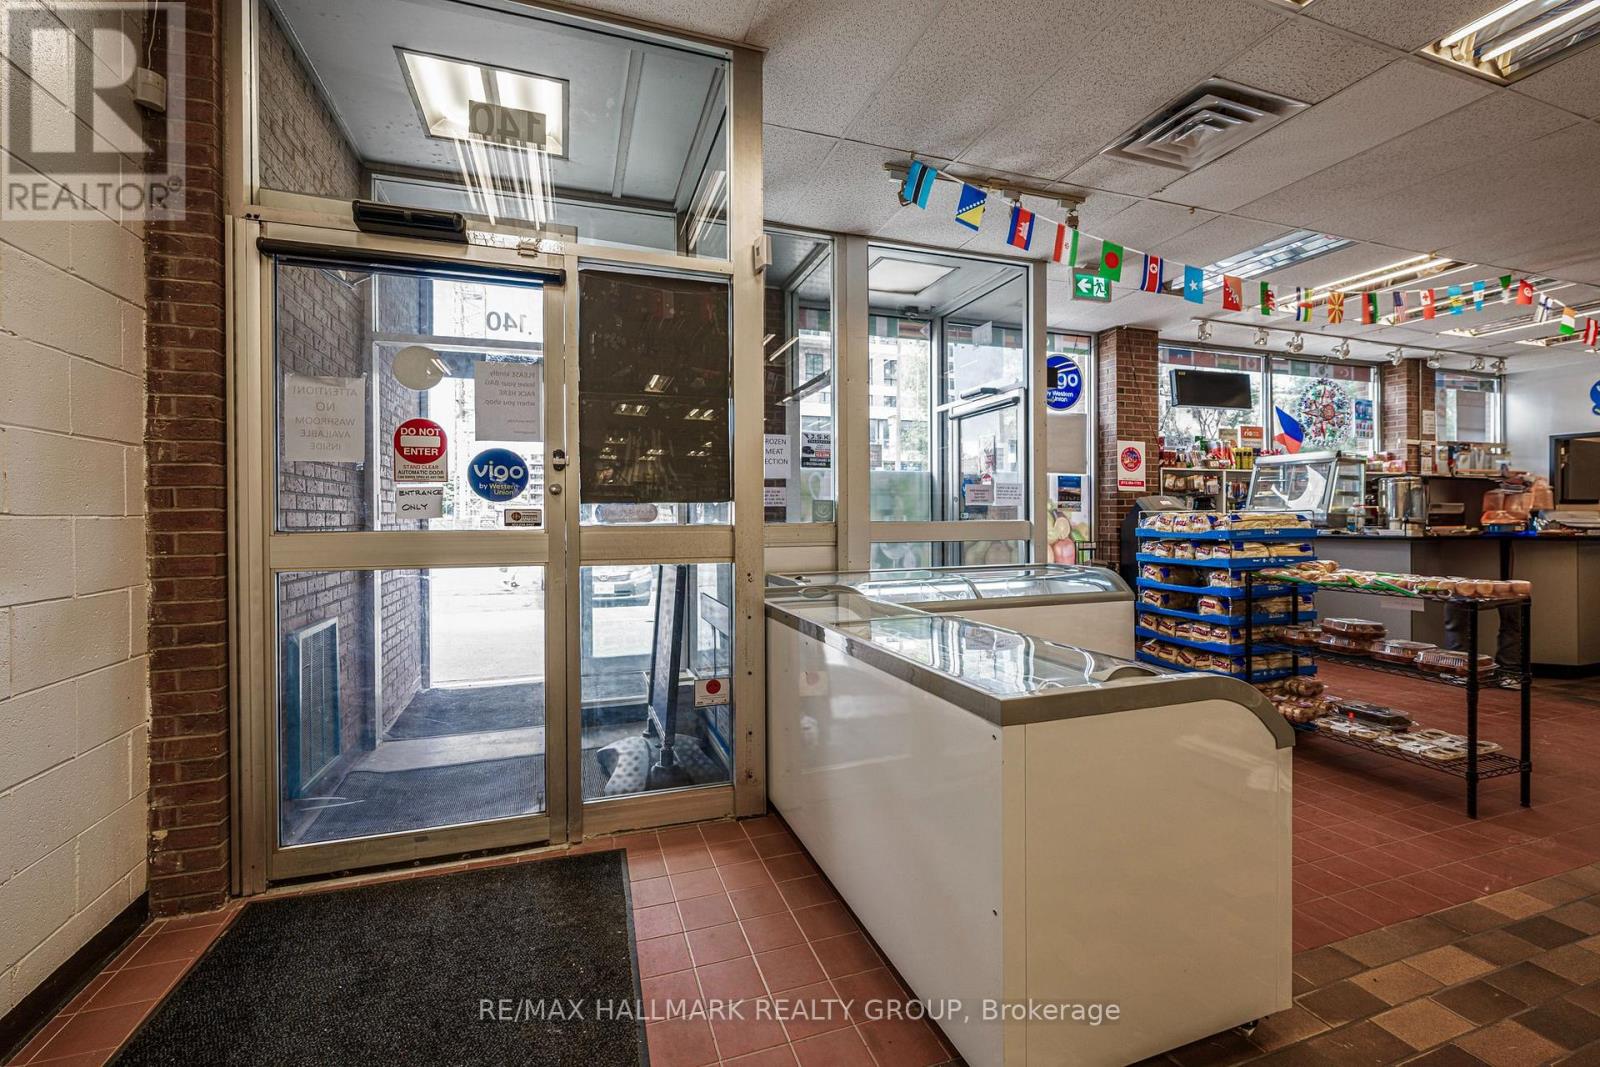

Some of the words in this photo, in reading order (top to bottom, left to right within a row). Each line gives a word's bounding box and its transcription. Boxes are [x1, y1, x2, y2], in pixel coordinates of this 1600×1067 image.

[400, 428, 416, 436] DO
[419, 428, 441, 436] NOT
[403, 447, 439, 456] ENTER
[473, 460, 524, 481] vigo
[401, 503, 429, 511] ONLY
